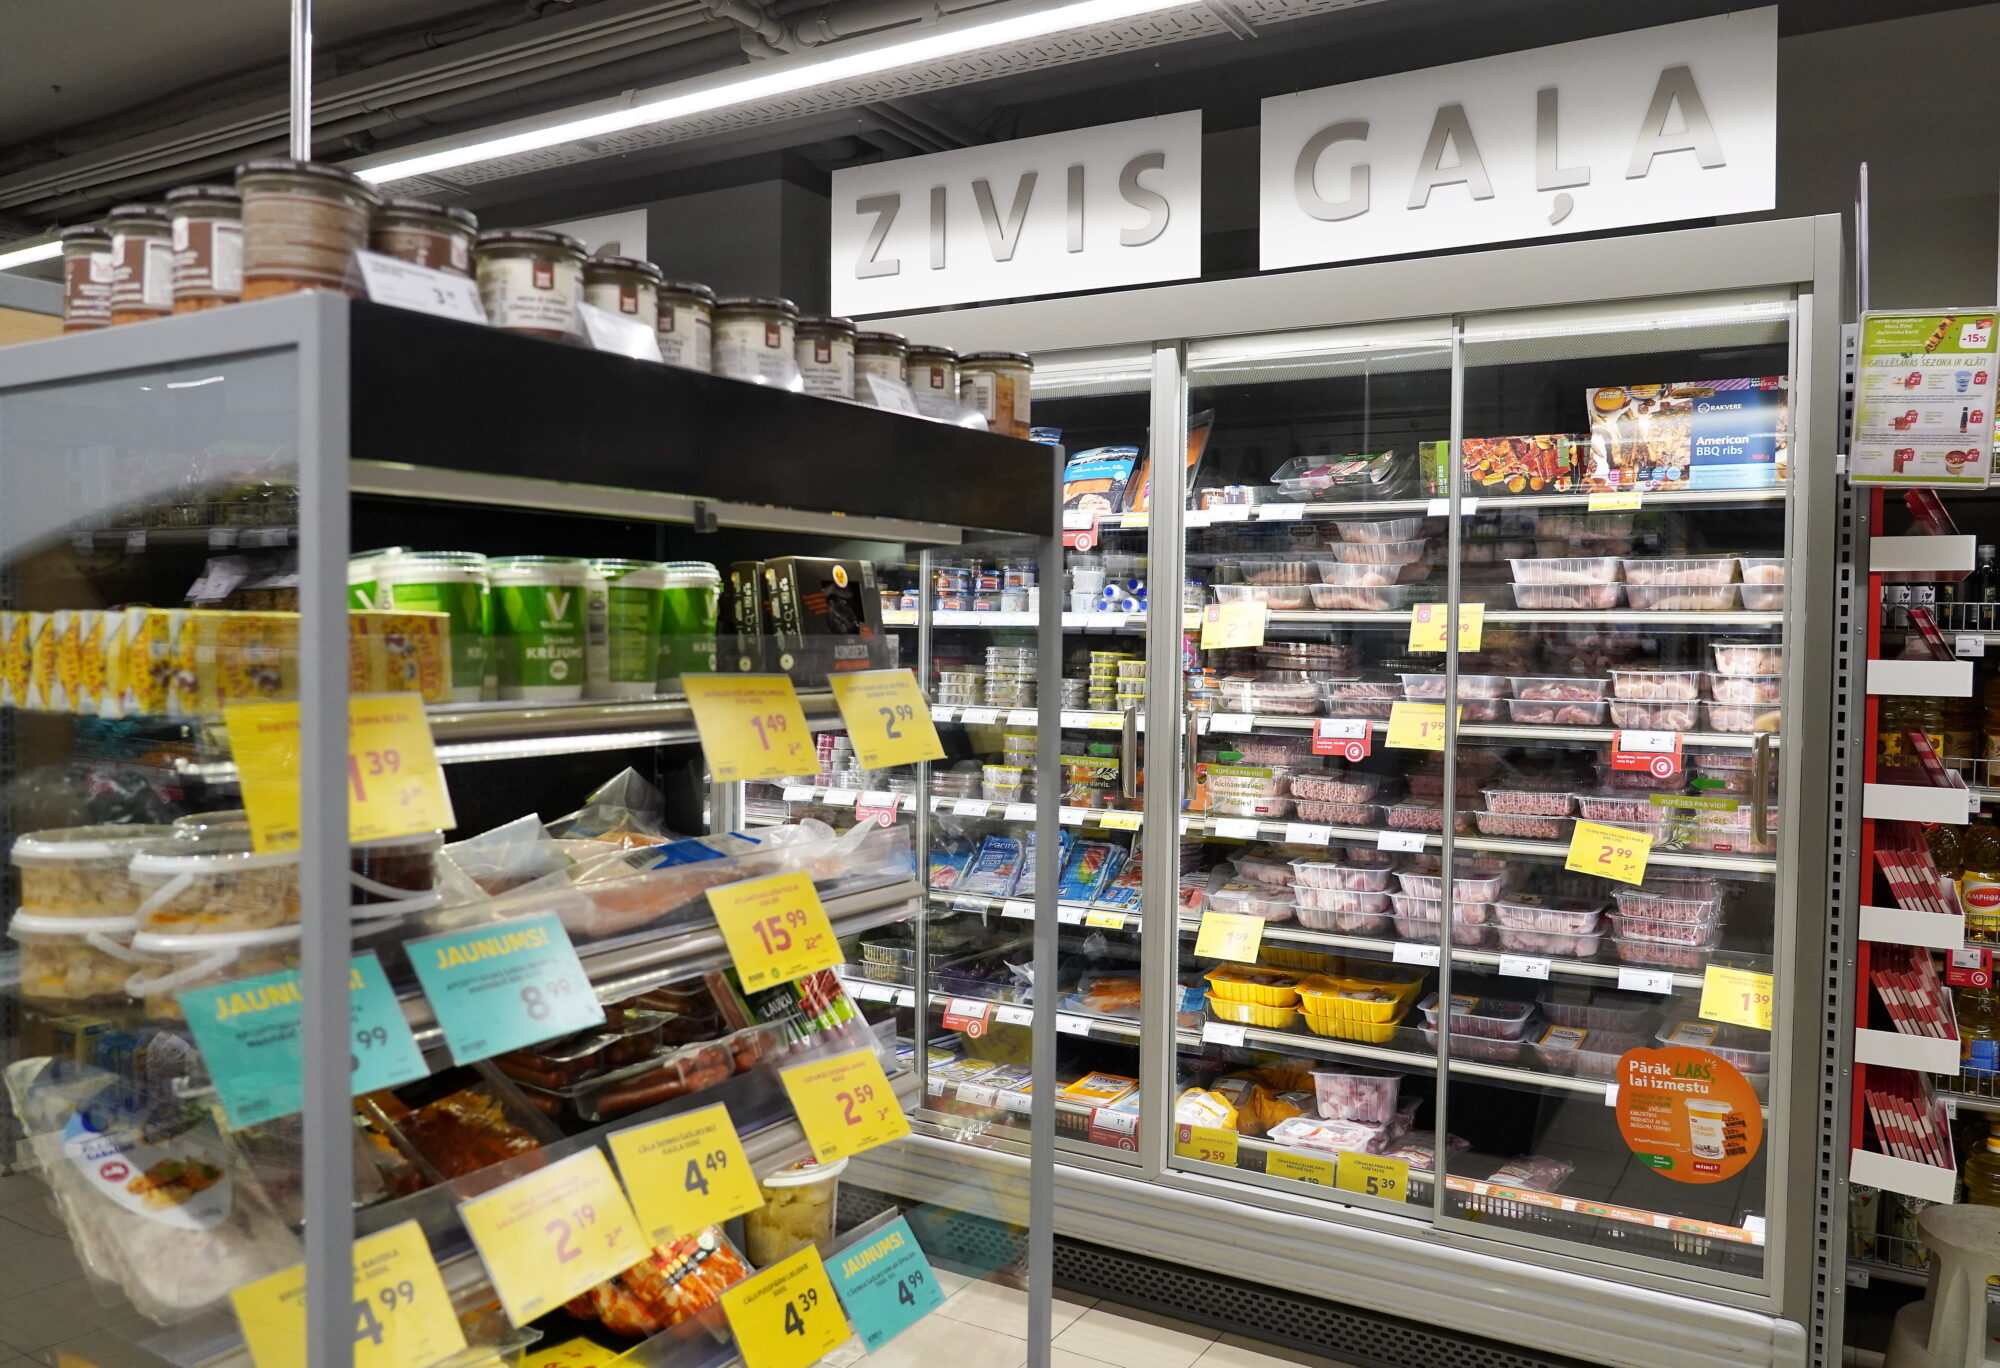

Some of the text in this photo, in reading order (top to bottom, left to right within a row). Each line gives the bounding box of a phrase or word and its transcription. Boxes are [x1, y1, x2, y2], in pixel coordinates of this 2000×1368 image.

[1294, 65, 1727, 226] GAĻA
[854, 150, 1172, 280] ZIVIS
[1962, 333, 1987, 343] -15%
[1710, 403, 1743, 411] RAKVERE
[1696, 435, 1749, 446] American
[1696, 445, 1743, 457] BBQ ribs
[436, 927, 550, 970] JAUNUMS!
[1629, 1060, 1671, 1076] Pārāk
[1629, 1074, 1709, 1094] lai izmestu
[841, 1231, 905, 1278] JAUNUMS!
